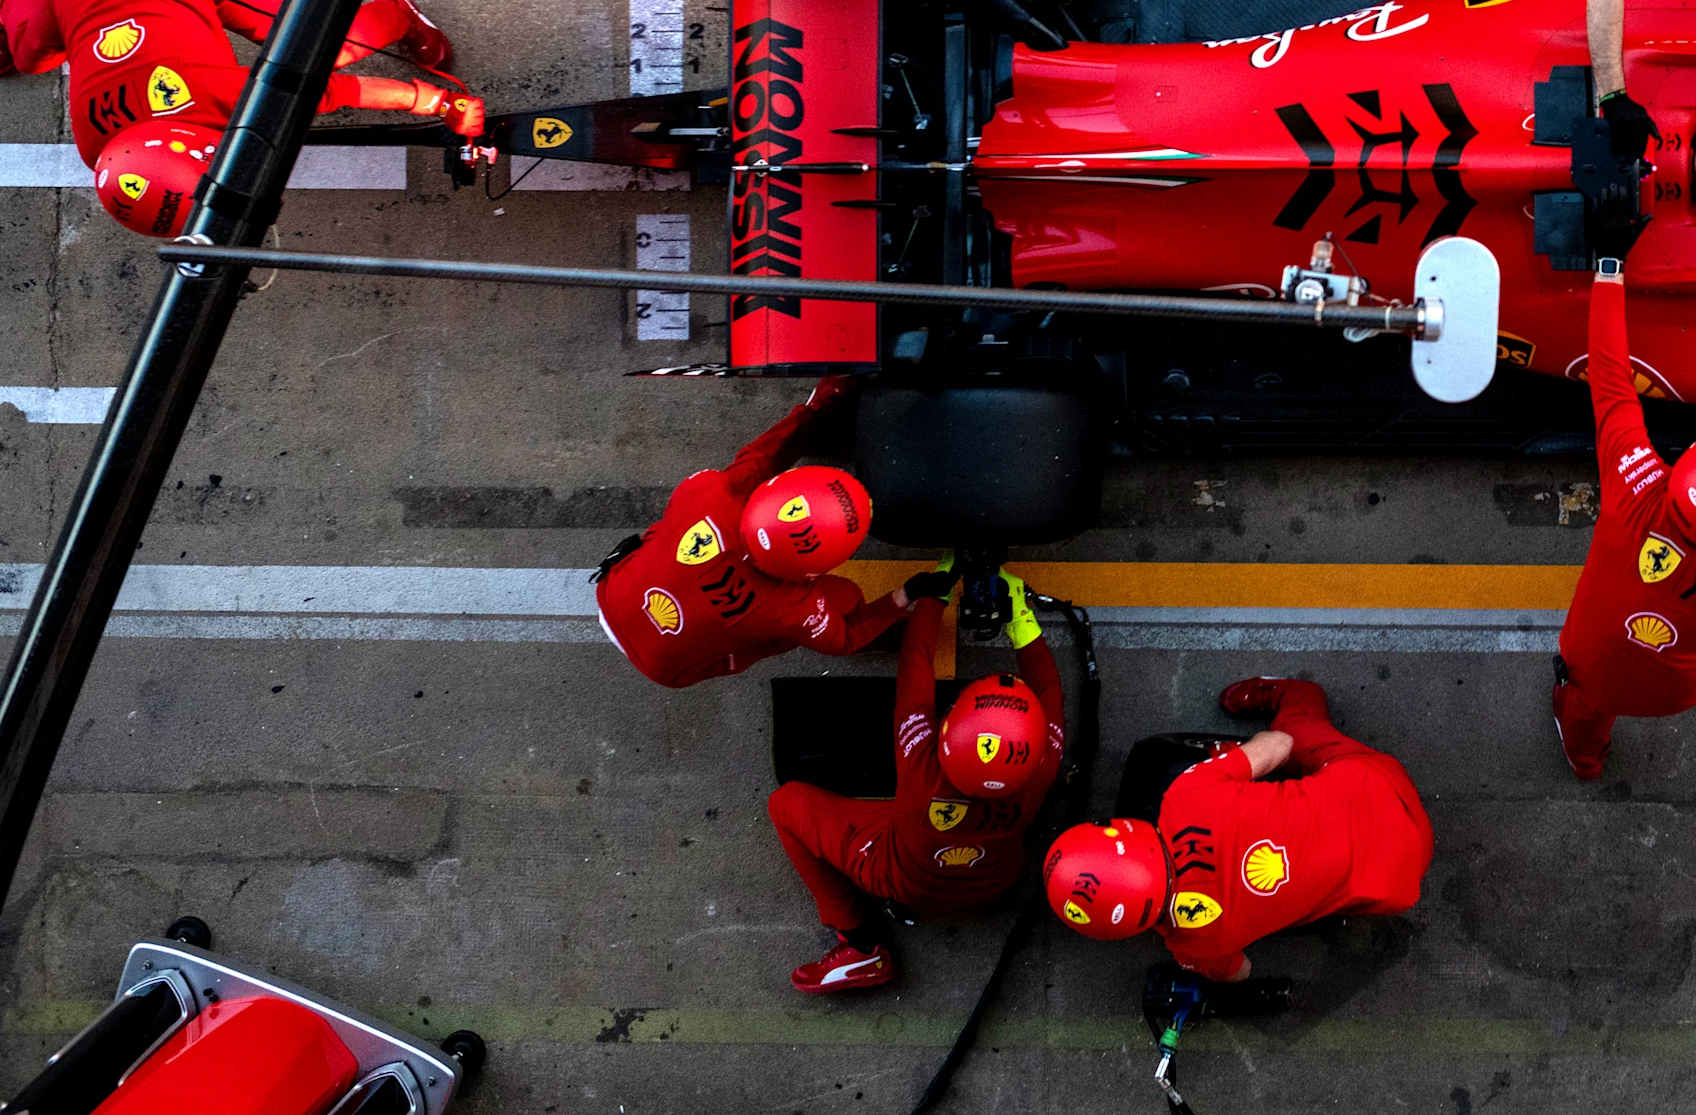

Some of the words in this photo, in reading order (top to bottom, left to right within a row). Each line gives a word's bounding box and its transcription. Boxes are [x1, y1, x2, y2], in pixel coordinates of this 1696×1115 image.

[630, 23, 646, 39] 2
[689, 23, 704, 39] 2
[1202, 1, 1430, 68] Ray-Ban
[630, 58, 643, 74] 1
[689, 58, 700, 74] 1
[734, 17, 769, 323] MISSION
[767, 17, 804, 321] WINNOW
[904, 728, 932, 758] HUBLOT
